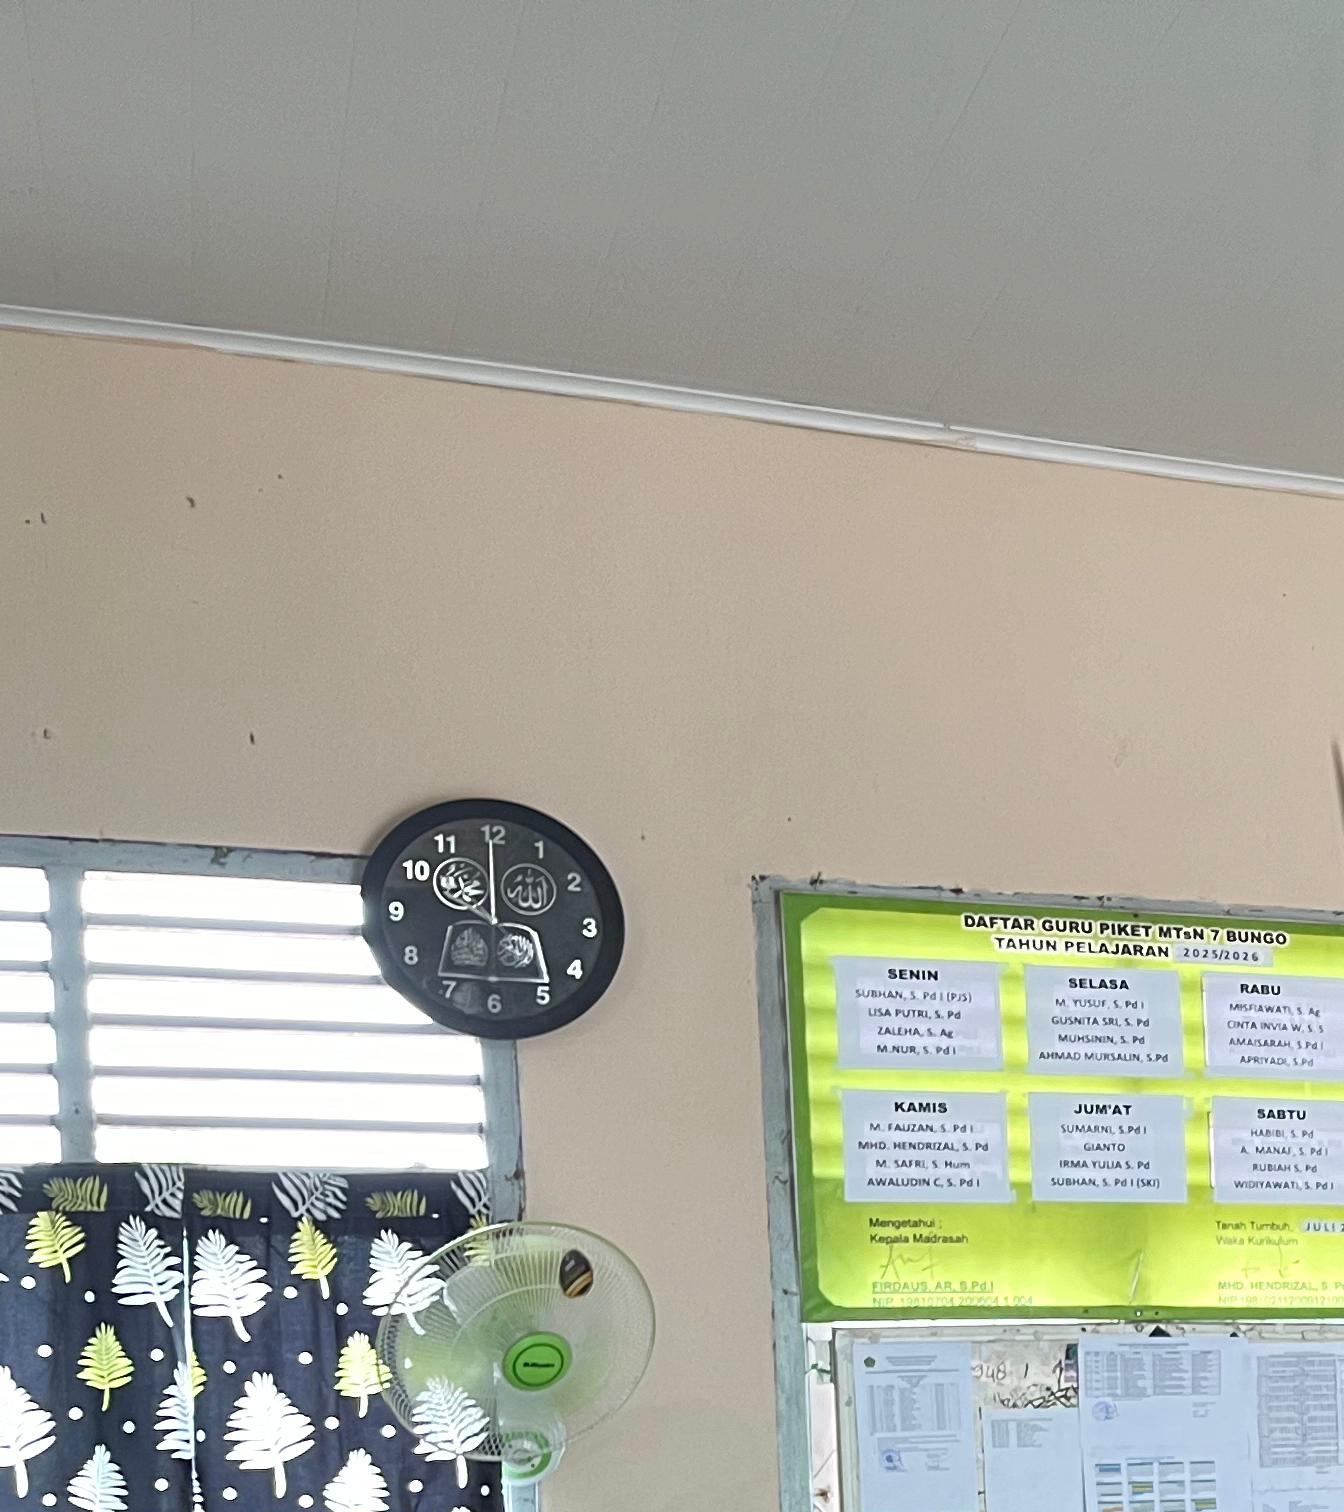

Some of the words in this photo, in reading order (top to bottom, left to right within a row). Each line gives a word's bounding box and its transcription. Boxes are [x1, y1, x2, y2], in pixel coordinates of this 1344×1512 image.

[480, 824, 506, 845] 12
[434, 834, 456, 854] 11
[534, 840, 544, 859] 1
[403, 860, 430, 881] 10
[567, 873, 582, 892] 2
[388, 901, 404, 921] 9
[582, 918, 597, 938] 3
[964, 914, 1035, 931] DAFTAR
[1042, 919, 1093, 934] GURU
[1100, 923, 1152, 938] PIKET
[1159, 926, 1204, 941] MTsN
[1211, 928, 1220, 941] 7
[1227, 930, 1287, 946] BUNGO
[404, 945, 418, 965] 8
[995, 937, 1057, 951] TAHUN
[1065, 940, 1169, 958] PELAJARAN
[1183, 948, 1259, 962] 2025/2026
[567, 959, 583, 980] 4
[888, 969, 938, 981] SENIN
[443, 981, 456, 998] 7
[1069, 978, 1129, 990] SELASA
[536, 986, 550, 1005] 5
[1240, 984, 1281, 996] RABU
[923, 992, 936, 1000] Pd
[487, 994, 501, 1013] 6
[1125, 1000, 1137, 1009] Pd
[869, 1008, 891, 1017] LISA
[948, 1010, 961, 1019] Pd
[1052, 1016, 1099, 1025] GUSNITA
[1137, 1018, 1149, 1027] Pd
[1133, 1036, 1145, 1044] Pd
[936, 1046, 949, 1055] Pd
[1039, 1052, 1081, 1060] AHMAD
[894, 1102, 948, 1113] KAMIS
[1074, 1104, 1132, 1115] JUM'AT
[1257, 1109, 1306, 1120] SABTU
[953, 1124, 966, 1133] Pd
[1302, 1130, 1314, 1139] Pd
[975, 1143, 988, 1151] Pd
[1084, 1143, 1125, 1152] GIANTO
[1311, 1148, 1322, 1156] Pd
[945, 1161, 970, 1169] Hum
[1059, 1160, 1088, 1168] IRMA
[1138, 1161, 1150, 1170] Pd
[1253, 1164, 1291, 1172] RUBIAH
[1306, 1164, 1317, 1173] Pd
[867, 1178, 930, 1187] AWALUDIN
[960, 1178, 973, 1187] Pd
[1115, 1178, 1127, 1187] Pd
[1316, 1182, 1327, 1190] Pd
[869, 1217, 935, 1229] Mengetahui
[1216, 1221, 1246, 1231] Tanah
[1306, 1222, 1335, 1232] JULI
[870, 1233, 909, 1245] Kepala
[913, 1233, 968, 1244] Madrasah
[1250, 1236, 1298, 1246] Kurikulum
